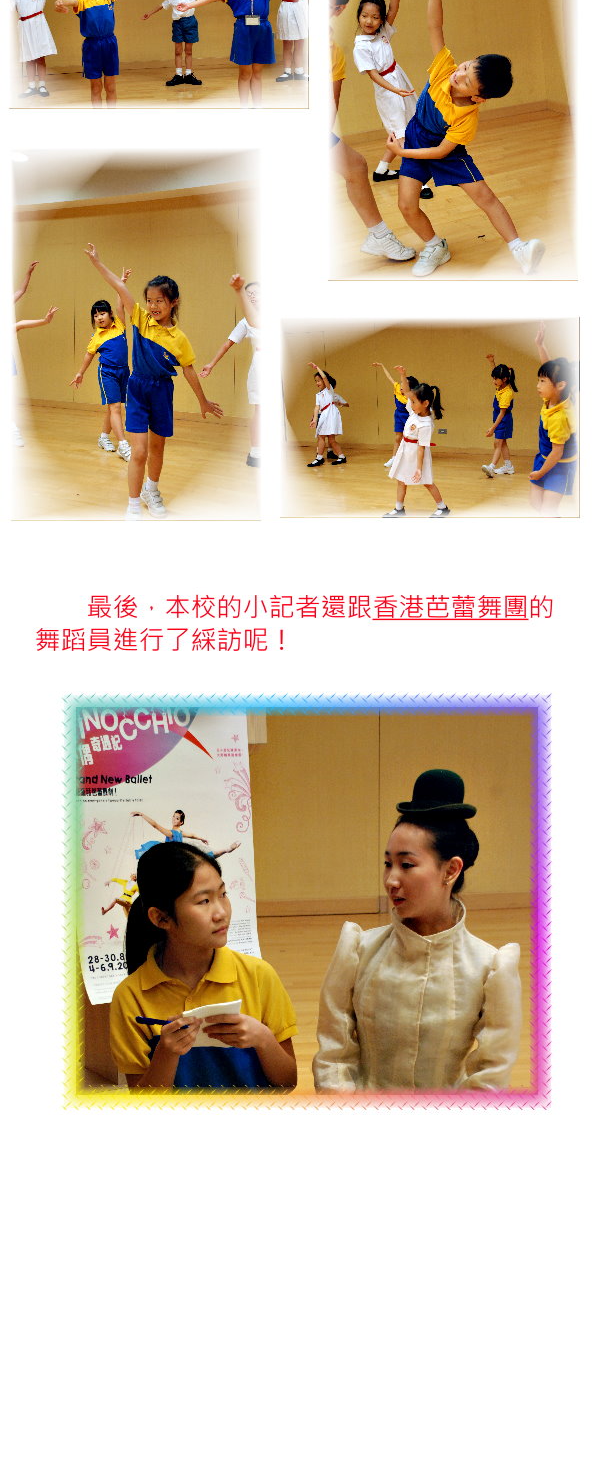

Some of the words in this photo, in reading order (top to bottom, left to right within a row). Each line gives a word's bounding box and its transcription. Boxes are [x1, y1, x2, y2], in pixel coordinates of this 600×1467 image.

[101, 775, 122, 784] New
[125, 774, 153, 784] Ballet
[88, 953, 125, 964] 28-30.8
